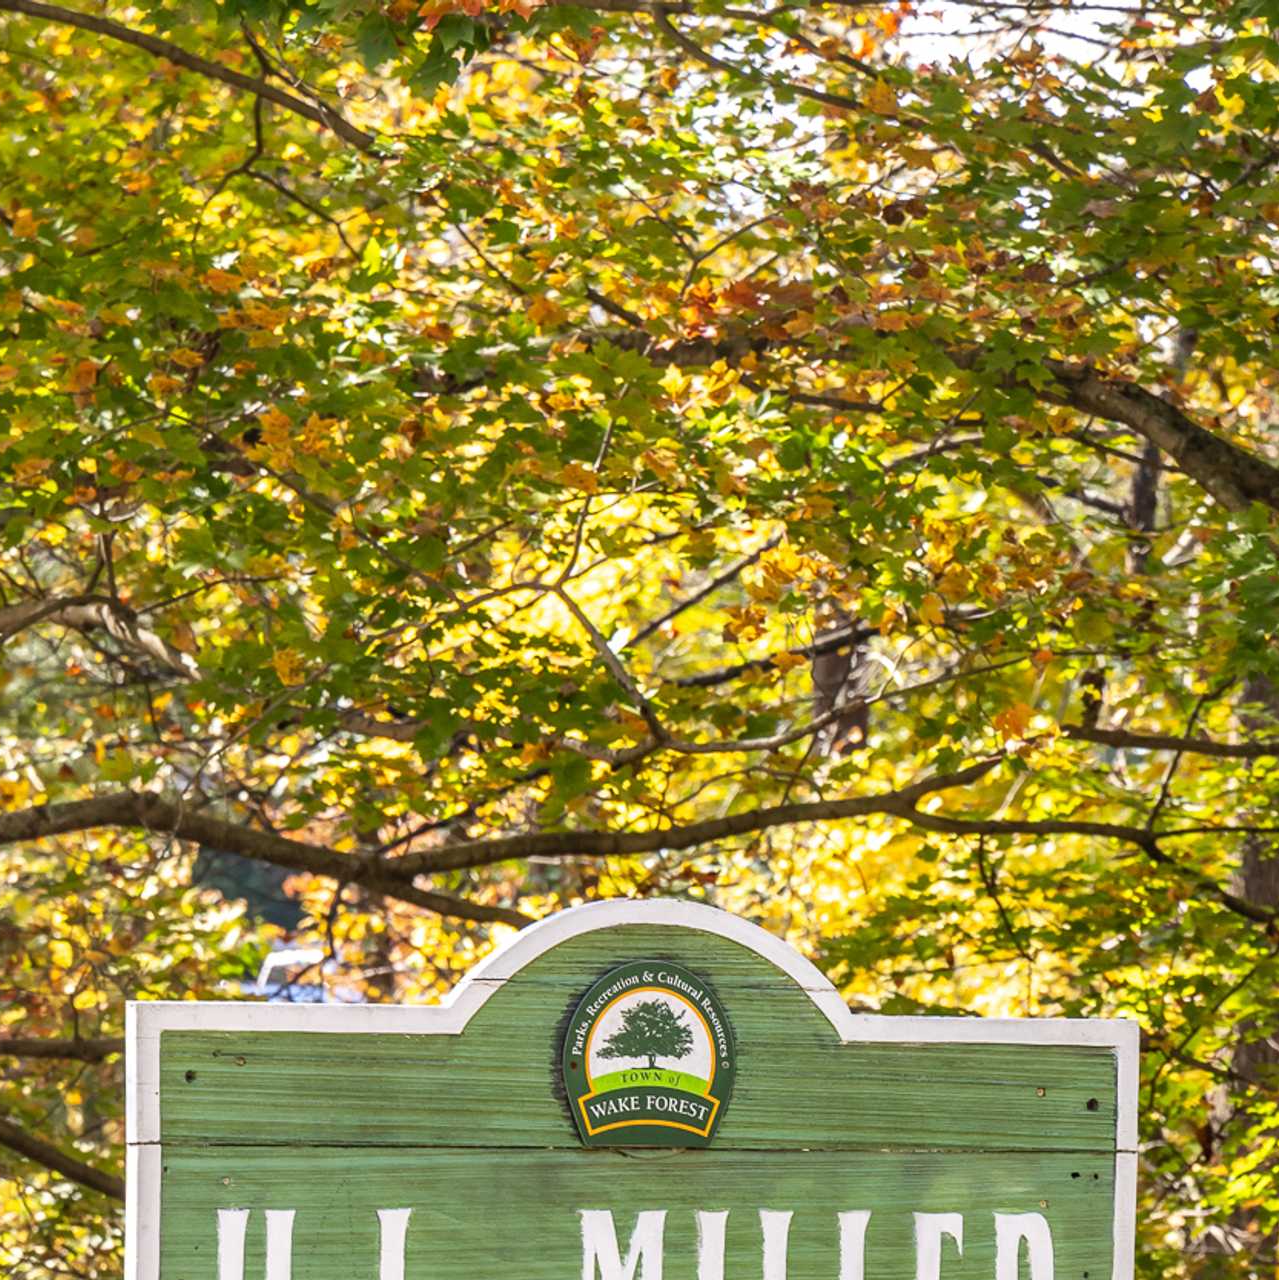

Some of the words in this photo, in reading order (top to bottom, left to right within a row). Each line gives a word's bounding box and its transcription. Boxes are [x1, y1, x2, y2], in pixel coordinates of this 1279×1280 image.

[572, 1018, 592, 1056] Parks,
[588, 976, 640, 1018] Recreation
[642, 970, 655, 983] &
[657, 972, 703, 1001] Cultural
[701, 998, 729, 1058] Resources
[620, 1073, 663, 1083] TOWN
[668, 1075, 681, 1086] of
[590, 1097, 640, 1119] WAKE
[646, 1096, 709, 1121] FOREST
